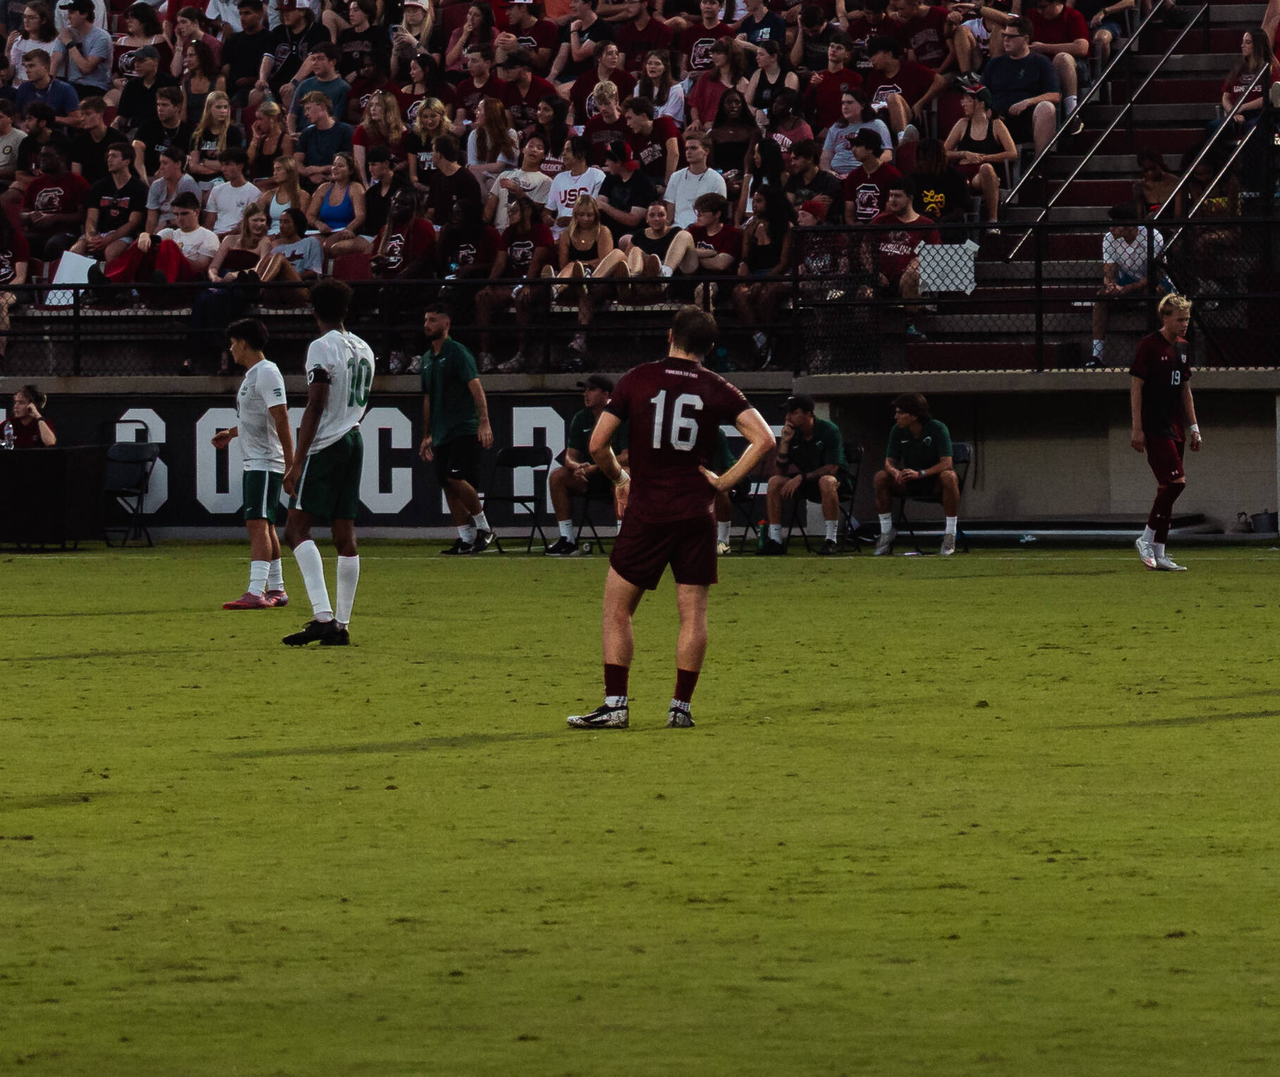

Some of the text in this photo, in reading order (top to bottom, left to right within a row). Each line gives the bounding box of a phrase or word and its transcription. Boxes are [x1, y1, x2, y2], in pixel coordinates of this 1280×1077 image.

[347, 356, 373, 409] 10
[1170, 369, 1181, 386] 19
[649, 389, 704, 452] 16
